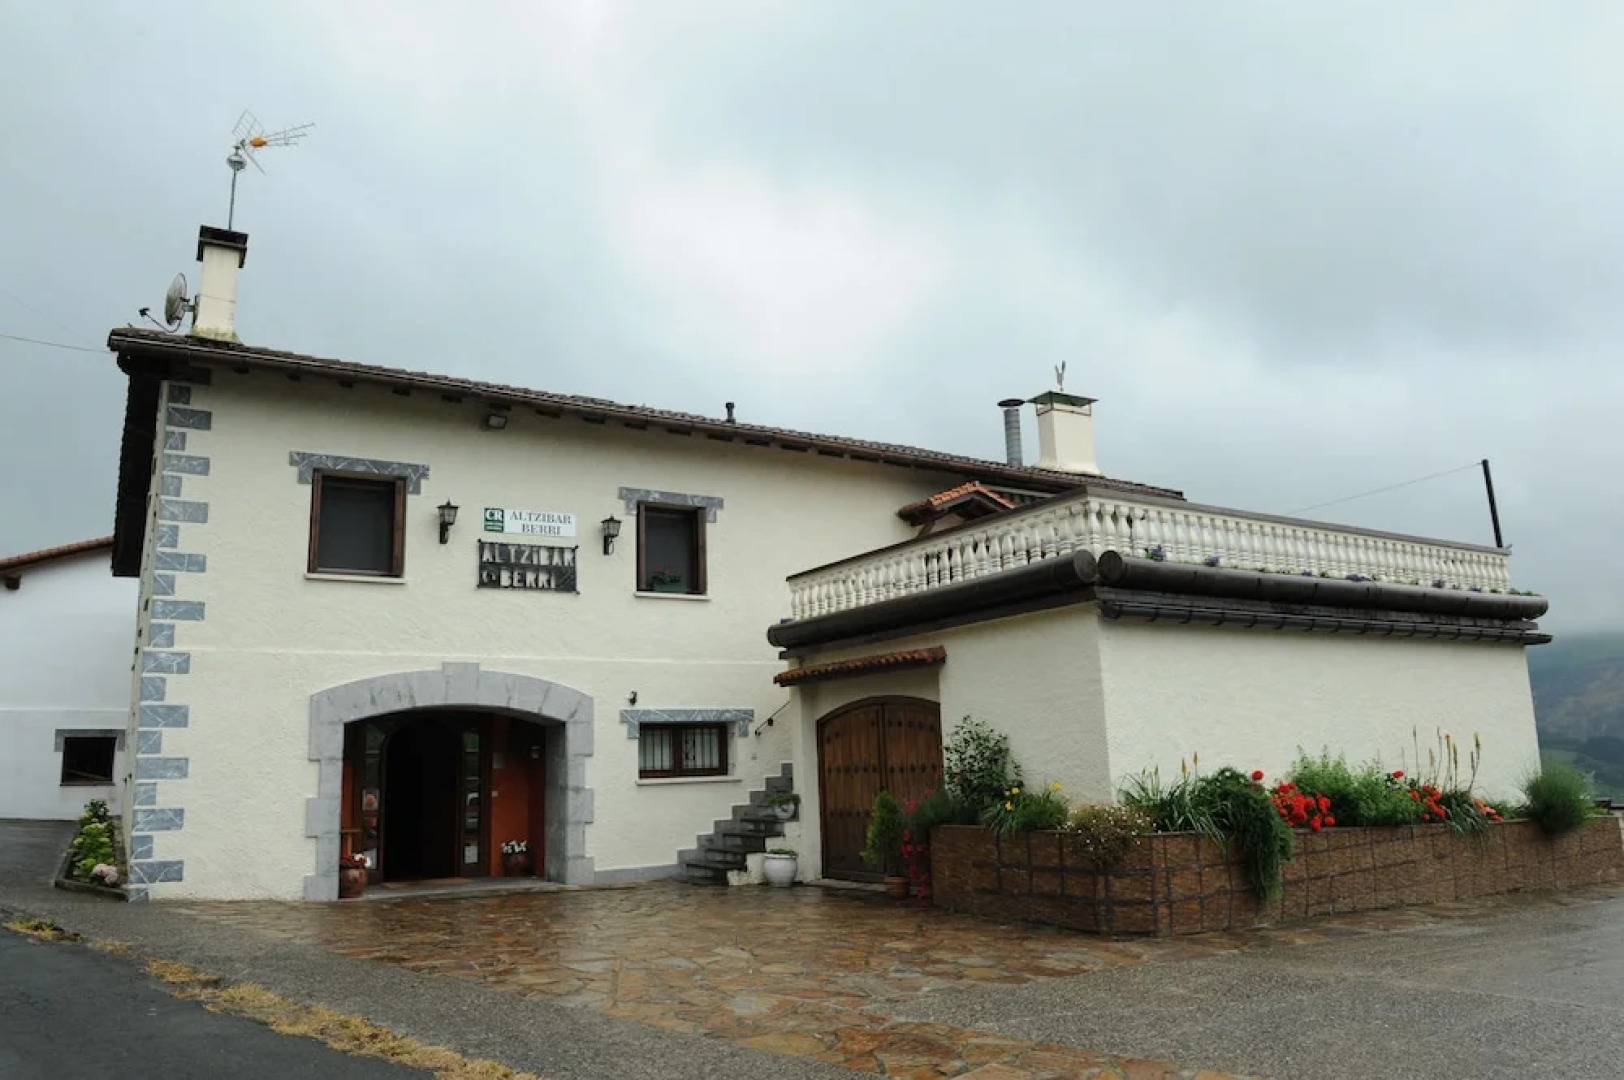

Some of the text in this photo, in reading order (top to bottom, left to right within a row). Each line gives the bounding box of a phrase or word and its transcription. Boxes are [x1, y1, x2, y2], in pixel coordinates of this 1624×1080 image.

[510, 511, 571, 524] ALTZIBAR
[522, 523, 561, 535] BERRI
[500, 569, 556, 589] BERRI
